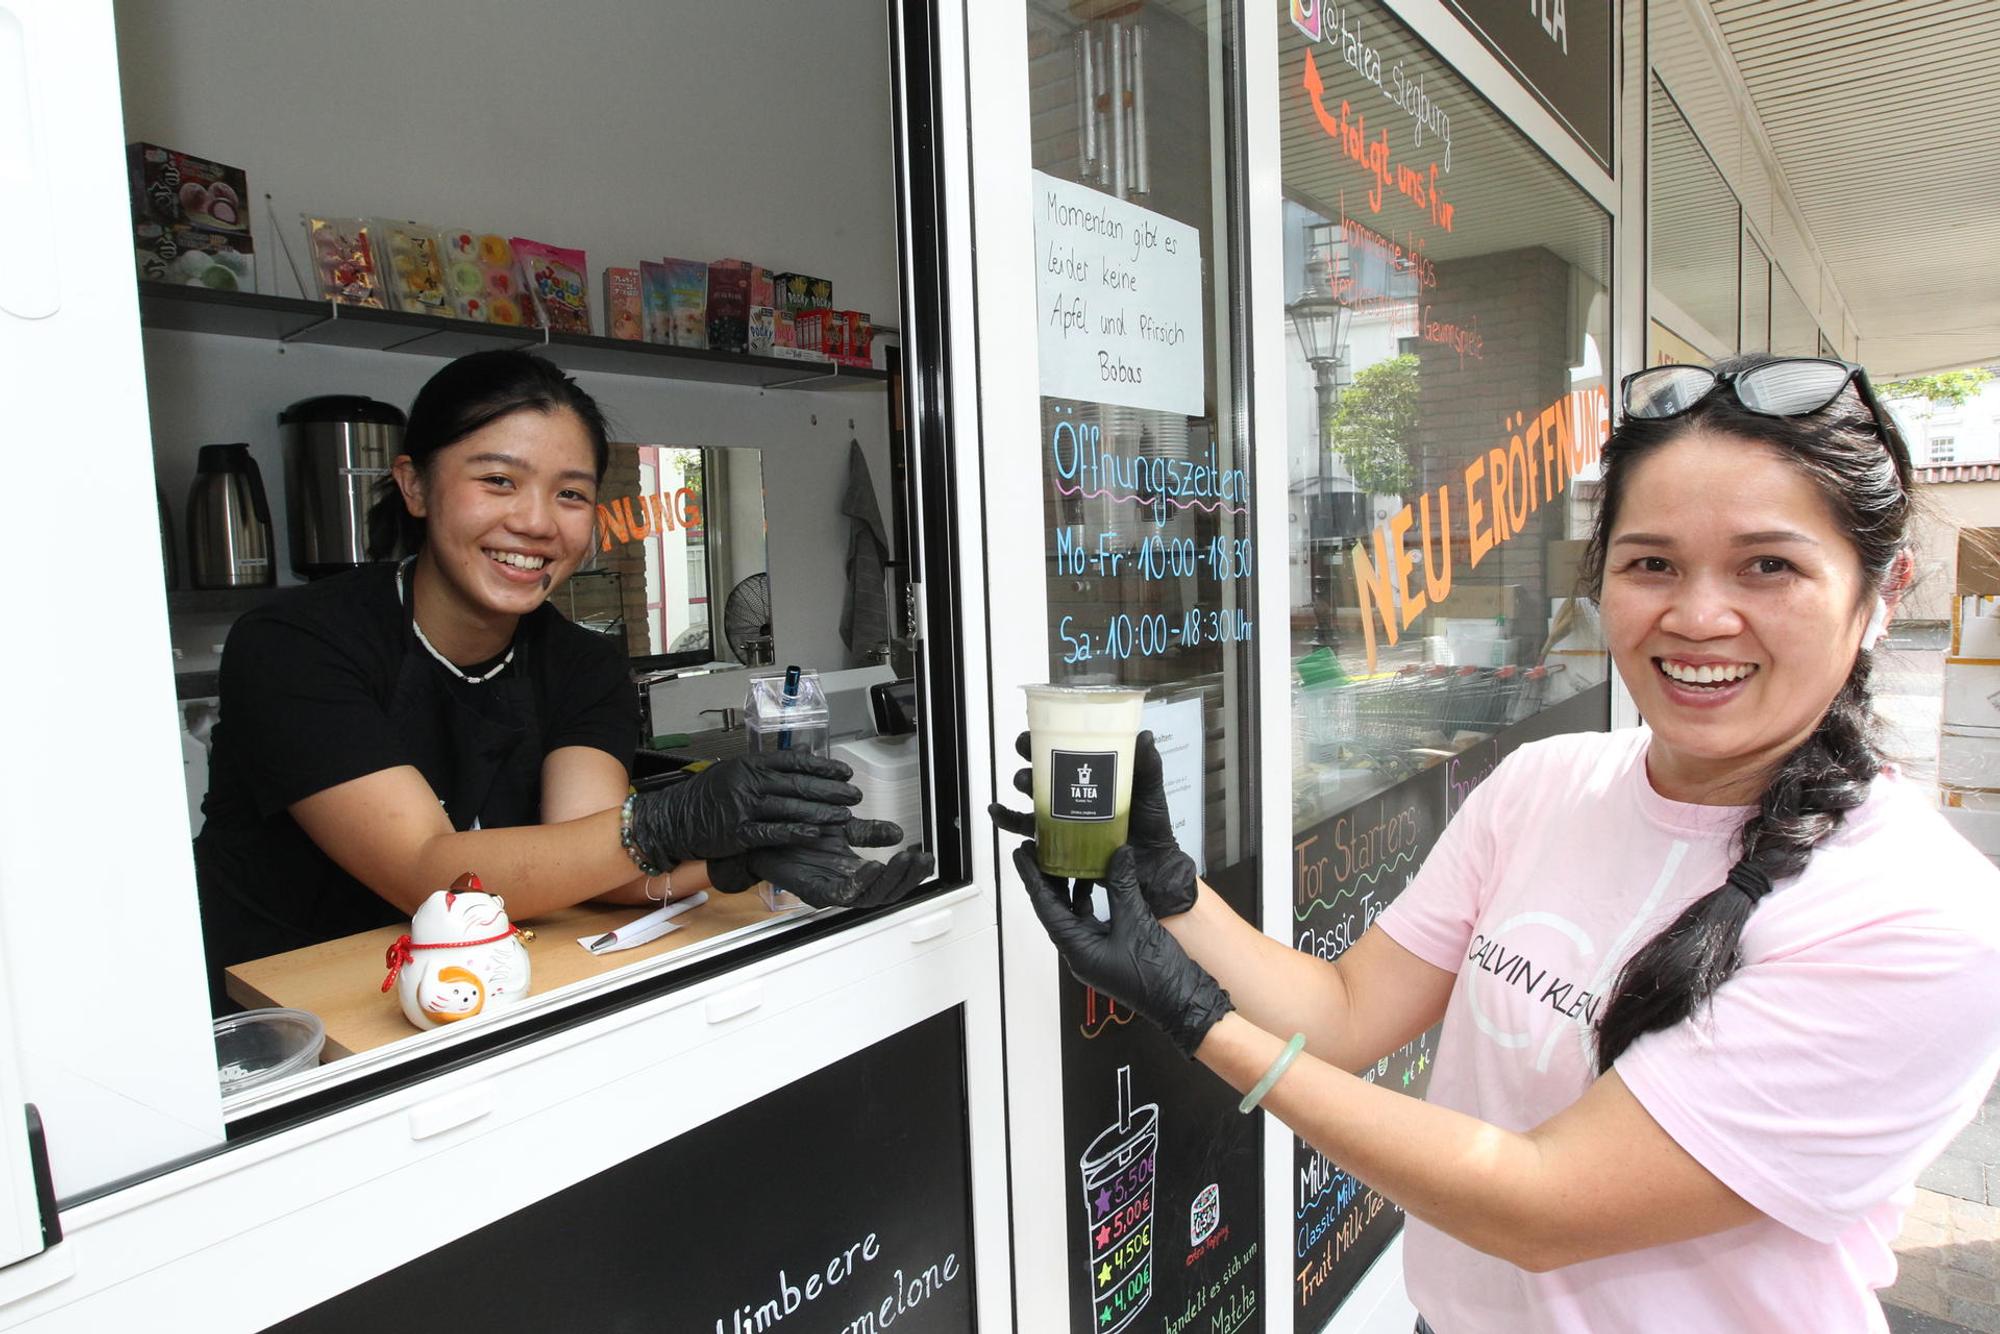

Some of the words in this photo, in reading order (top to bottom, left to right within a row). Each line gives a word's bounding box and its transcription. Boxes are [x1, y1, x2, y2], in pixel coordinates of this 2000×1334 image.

[1340, 100, 1392, 213] folgt
[1397, 164, 1426, 208] uns
[1047, 191, 1123, 240] Momentan
[1131, 221, 1158, 262] gibt
[1165, 236, 1178, 255] es
[1102, 256, 1137, 292] keine
[1050, 293, 1089, 339] Apfel
[1101, 308, 1127, 338] und
[1140, 314, 1185, 346] Pfirsich
[1098, 350, 1143, 384] Bobas
[1054, 405, 1248, 528] Öffnungszeiten
[1352, 484, 1452, 675] NEU
[1465, 383, 1611, 570] ERÖFFNUNG
[1060, 615, 1101, 664] Sa:
[1071, 787, 1081, 798] TA
[1083, 787, 1097, 798] TEA
[1294, 835, 1328, 905] For
[1298, 912, 1356, 961] Classic
[1469, 934, 1547, 994] CALVIN
[1114, 1152, 1155, 1204] 5,50€
[1300, 1150, 1330, 1209] Milk
[1113, 1191, 1150, 1239] 5,00€
[1297, 1206, 1335, 1258] Classic
[1337, 1176, 1357, 1215] Milk
[1114, 1224, 1150, 1271] 4,50€
[1297, 1239, 1333, 1307] Fruit
[1336, 1206, 1363, 1263] Milk
[1364, 1190, 1385, 1226] Tea
[1114, 1263, 1150, 1311] 4,00€
[1164, 1286, 1206, 1334] handelt
[1210, 1281, 1221, 1299] es
[1223, 1255, 1242, 1286] sich
[1243, 1242, 1258, 1265] um
[1211, 1285, 1256, 1334] Matcha
